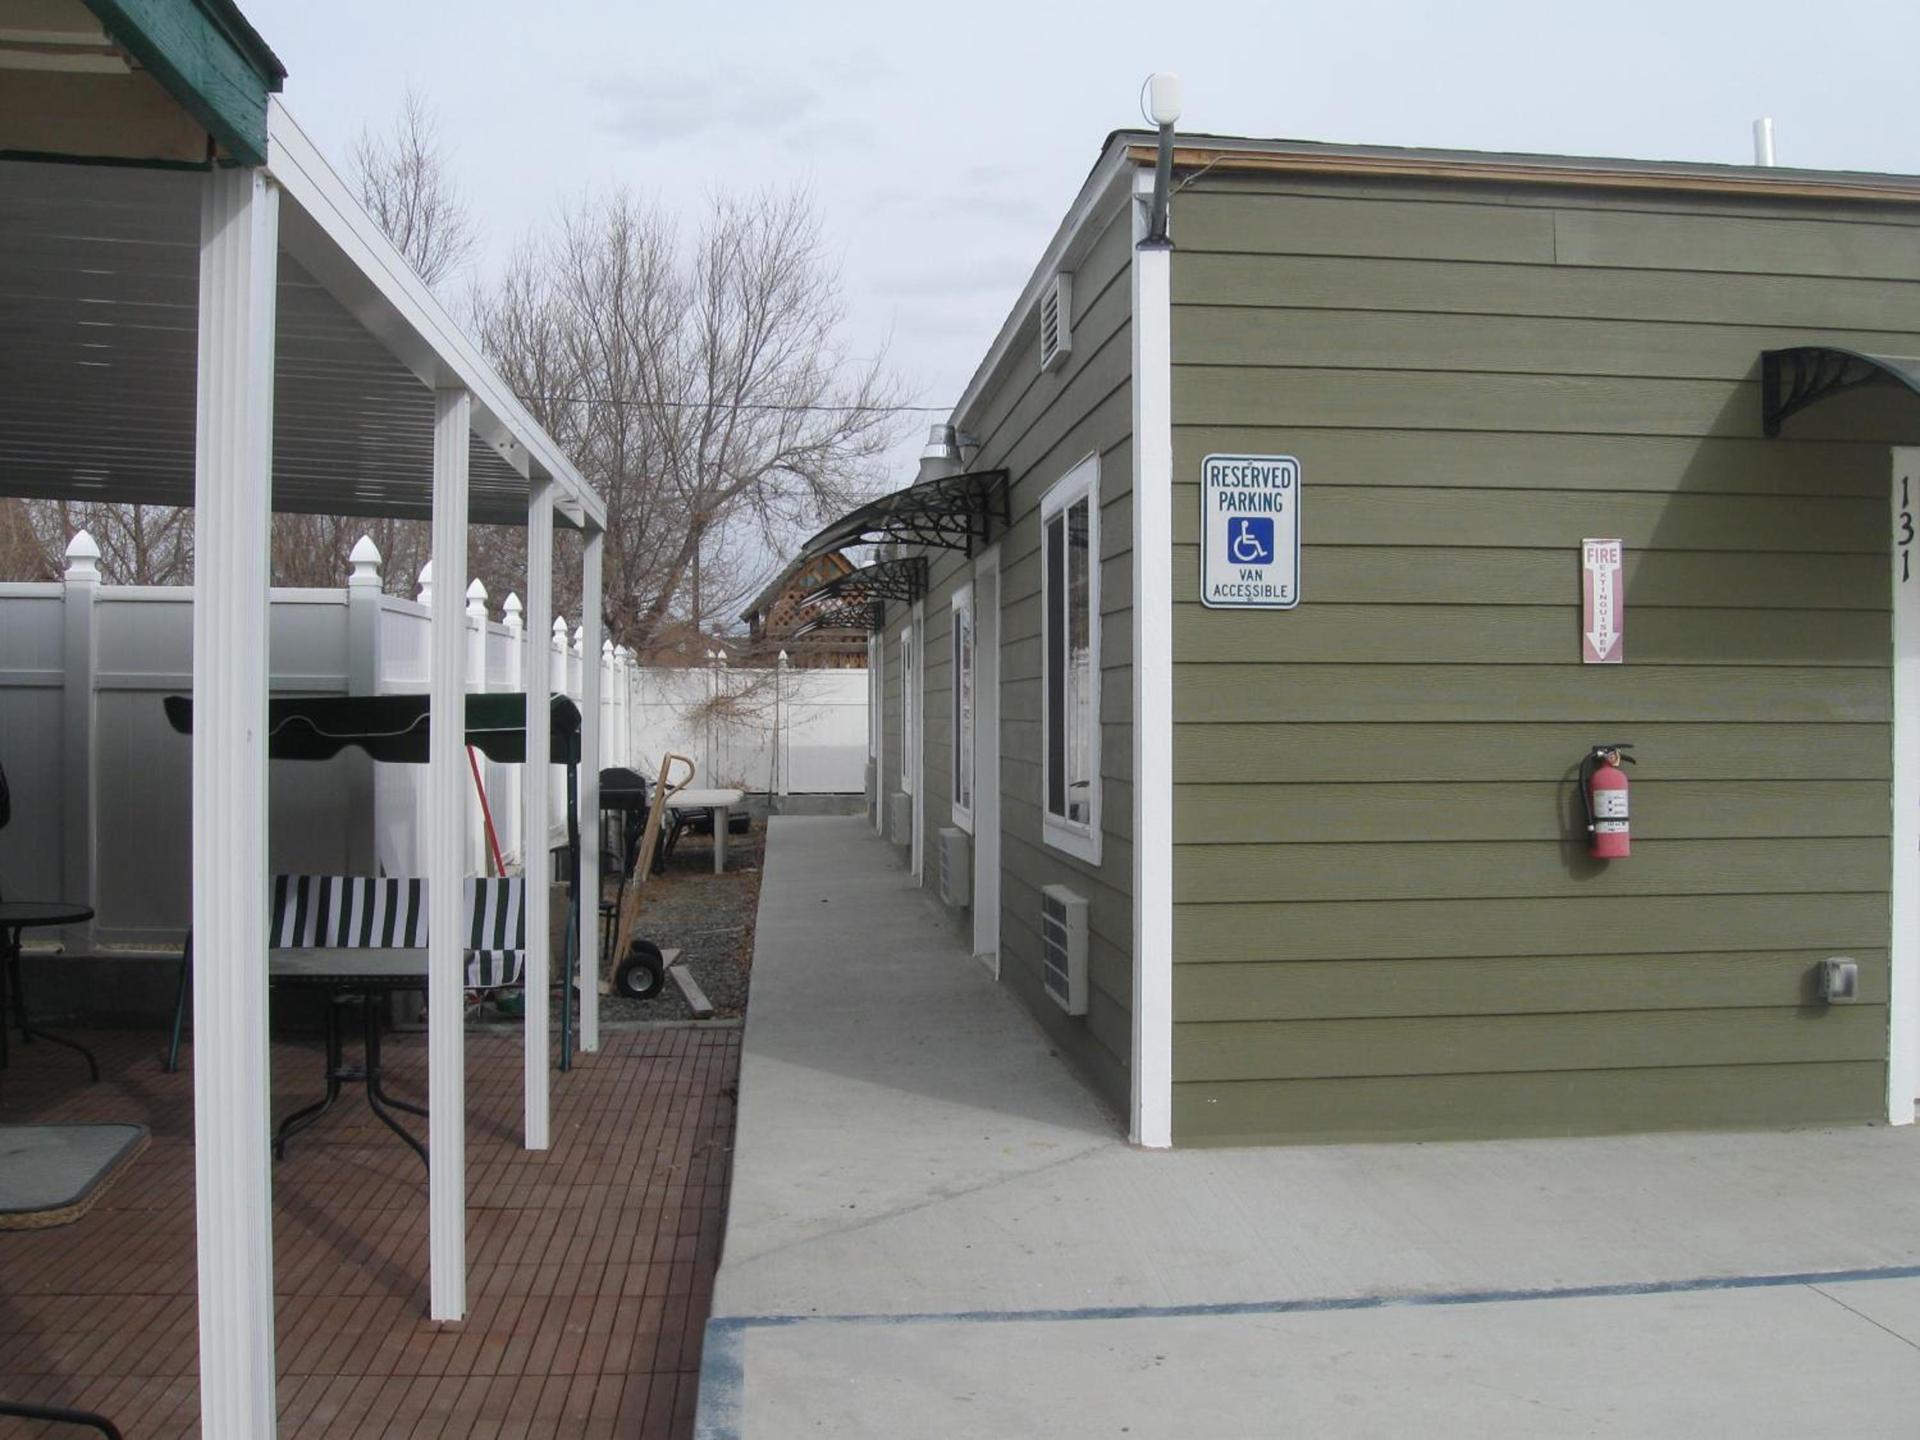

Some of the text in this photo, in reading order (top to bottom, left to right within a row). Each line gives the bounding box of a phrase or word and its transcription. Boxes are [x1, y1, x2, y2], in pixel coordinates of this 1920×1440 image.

[1211, 466, 1291, 488] RESERVED
[1219, 491, 1283, 512] PARKING
[1897, 475, 1915, 583] 131
[1587, 548, 1617, 564] FIRE
[1239, 569, 1263, 581] VAN
[1213, 584, 1288, 598] ACCESSIBLE
